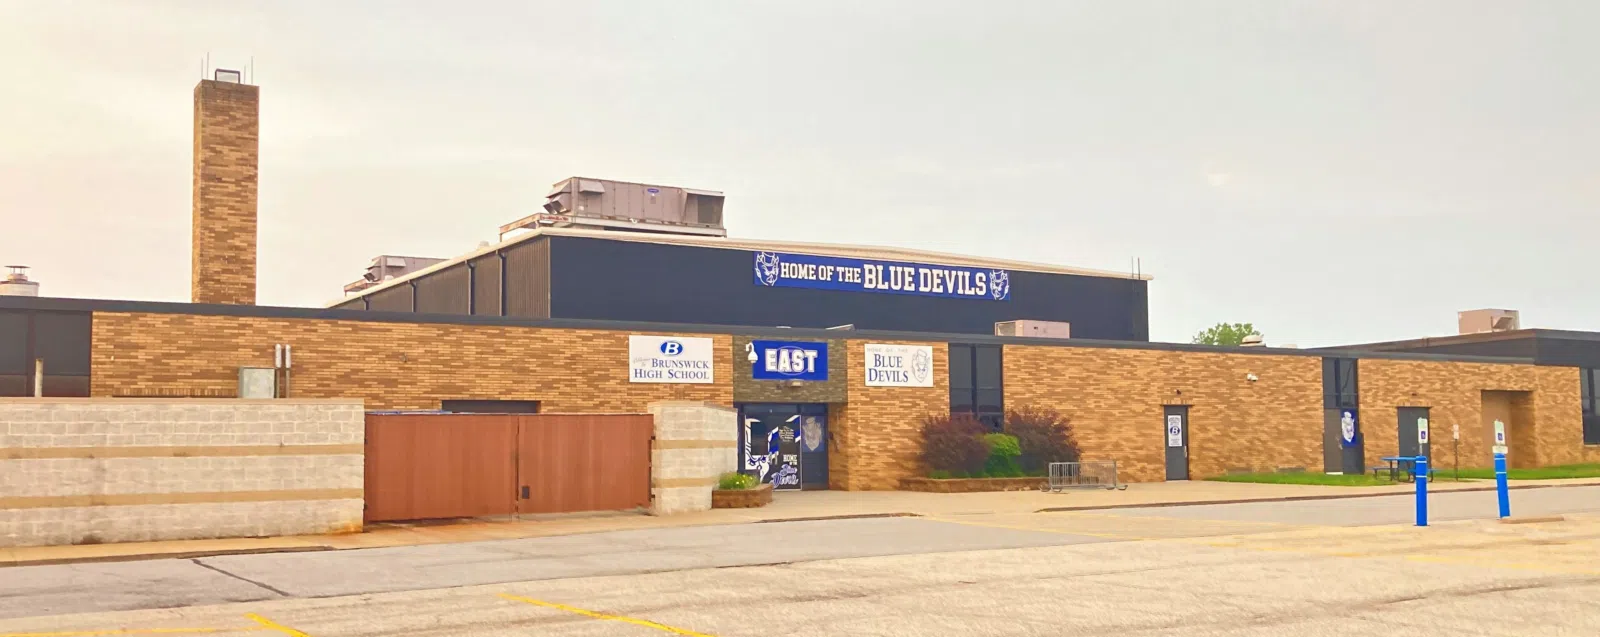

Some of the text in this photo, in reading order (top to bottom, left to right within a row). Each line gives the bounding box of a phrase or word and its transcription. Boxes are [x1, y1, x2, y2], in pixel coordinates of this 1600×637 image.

[780, 262, 987, 296] HOME OF THE BLUE DEVILS
[664, 342, 680, 355] B
[652, 358, 709, 369] BRUNSWICK
[765, 348, 817, 373] EAST
[874, 354, 903, 368] BLUE
[634, 369, 710, 380] HIGH SCHOOL
[868, 368, 909, 382] DEVILS
